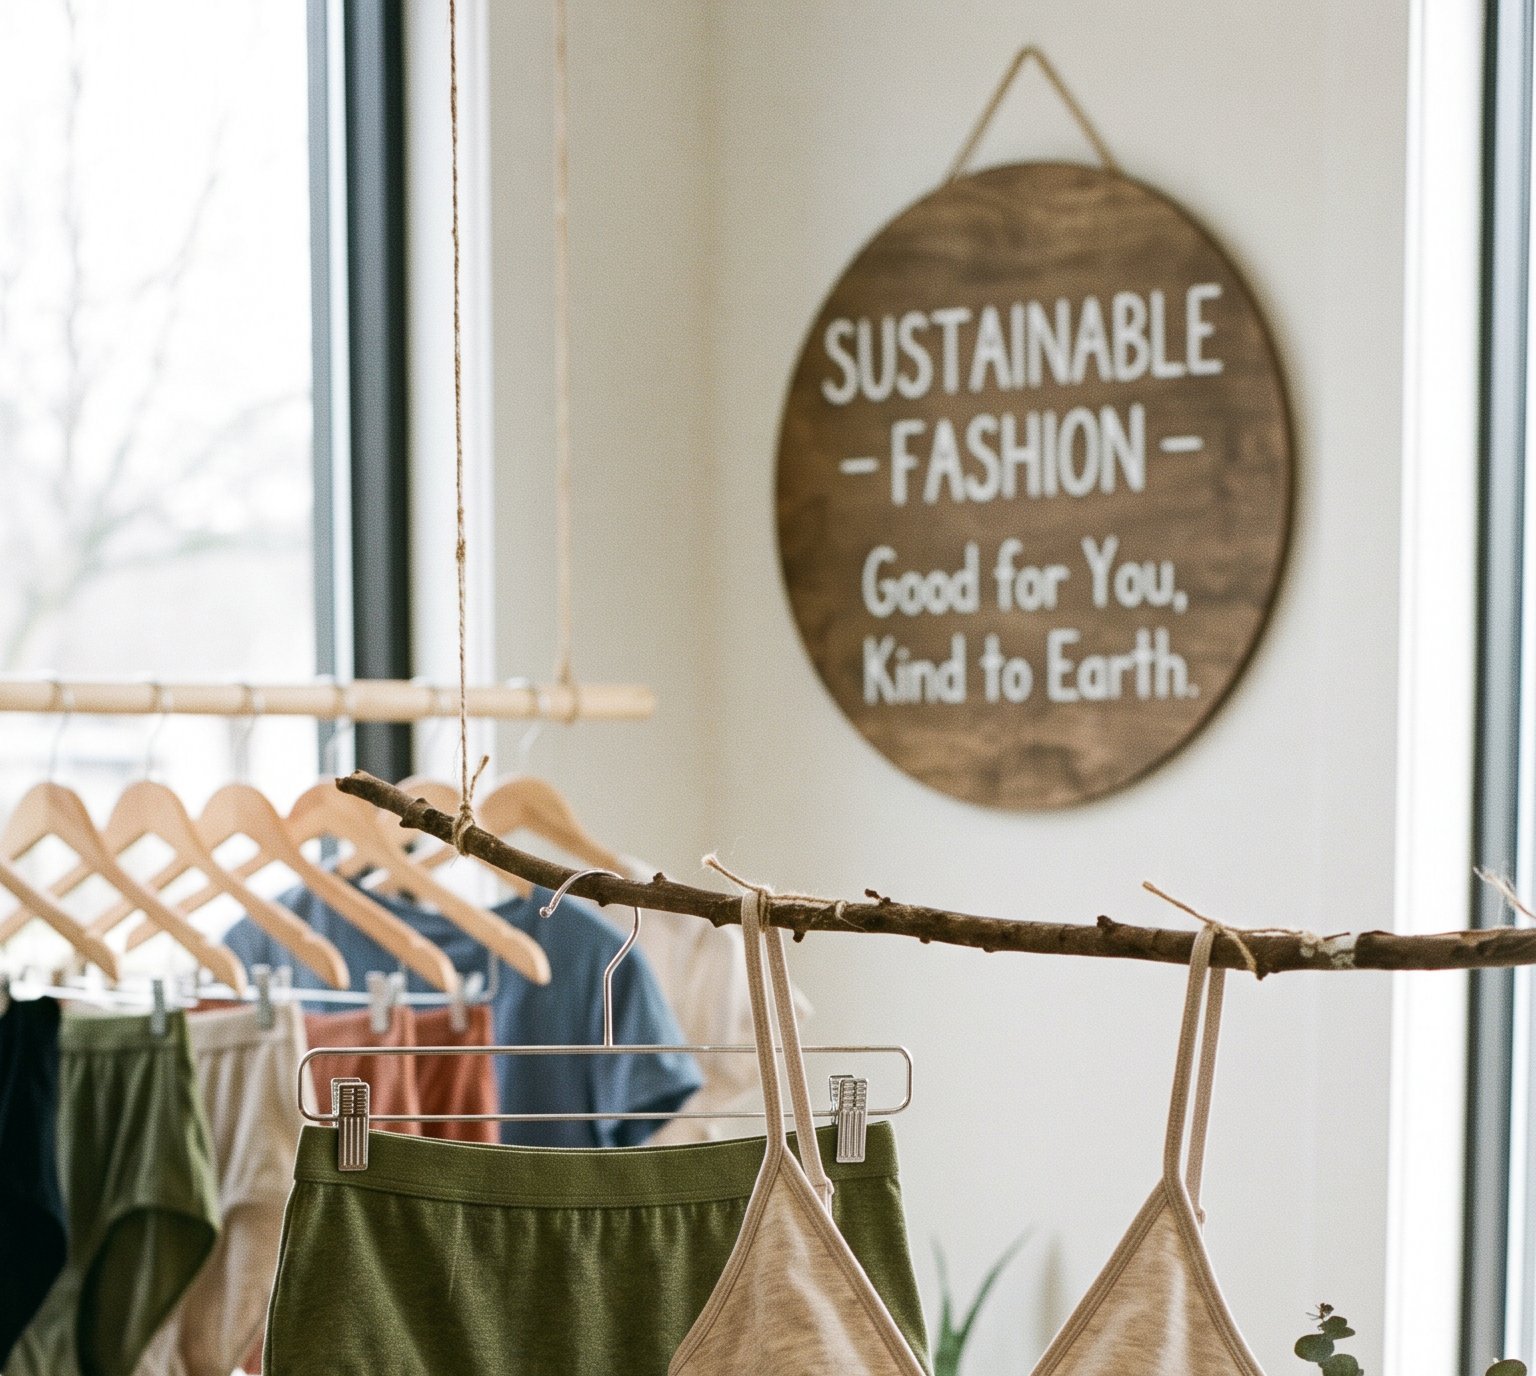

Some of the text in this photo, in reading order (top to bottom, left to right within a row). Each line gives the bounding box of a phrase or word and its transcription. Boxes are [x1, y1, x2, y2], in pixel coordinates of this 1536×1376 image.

[822, 283, 1223, 403] SUSTAINABLE
[890, 402, 1147, 507] FASHION
[861, 535, 1189, 618] Good for You,
[863, 627, 1199, 705] Kind to Earth.
